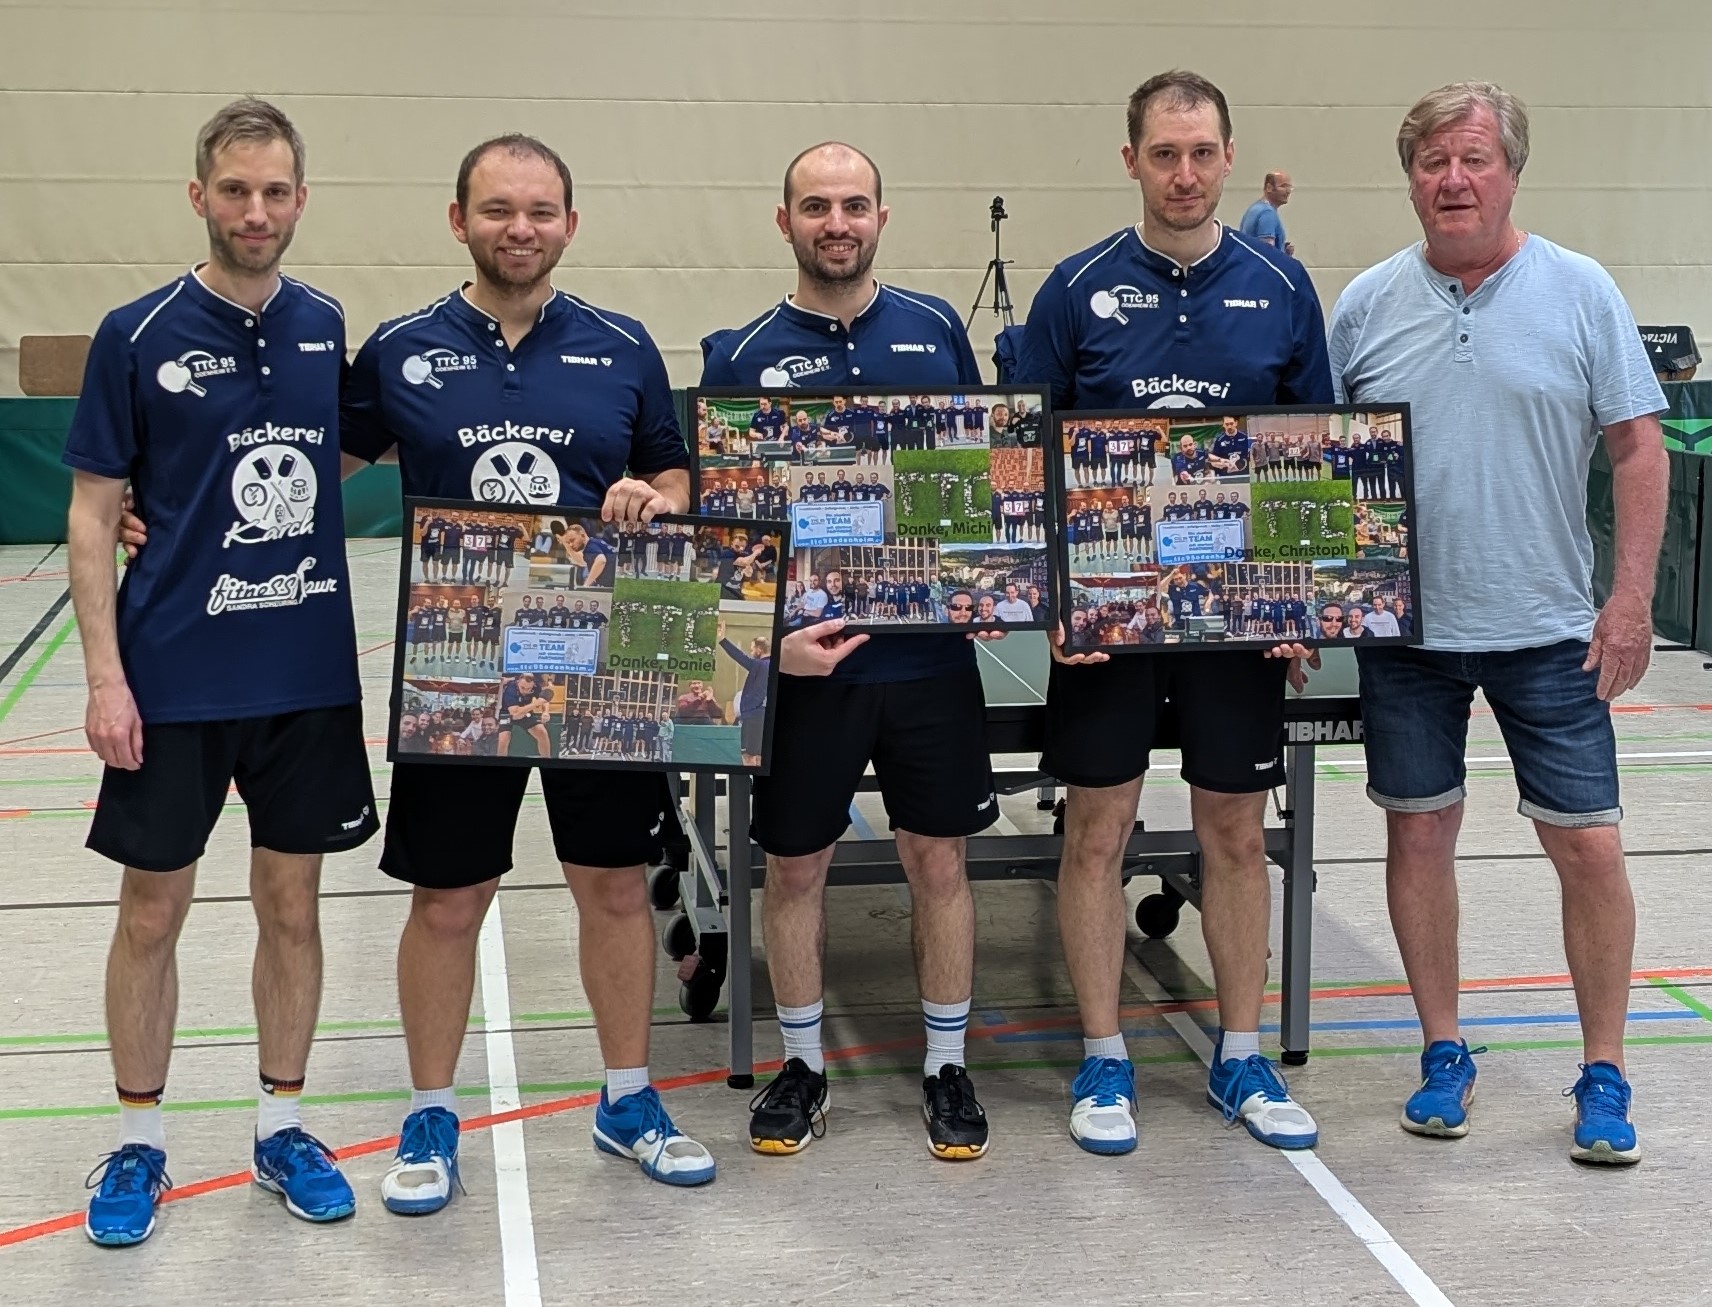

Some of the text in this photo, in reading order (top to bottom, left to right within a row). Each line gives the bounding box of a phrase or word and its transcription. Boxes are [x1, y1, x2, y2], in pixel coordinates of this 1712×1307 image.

[1121, 293, 1159, 304] TTC 95
[192, 356, 236, 371] TTC 95
[435, 354, 477, 367] TTC 95
[790, 355, 829, 373] TTC 95
[1131, 373, 1231, 399] Bäckerei
[227, 421, 325, 453] Bäckerei
[457, 420, 575, 448] Bäckerei
[222, 506, 315, 549] Karch
[896, 521, 992, 538] Danke, Michi
[1224, 545, 1276, 560] Danke,
[1279, 543, 1350, 559] Christoph
[609, 654, 717, 672] Danke, Daniel
[1283, 720, 1364, 742] IBHAR
